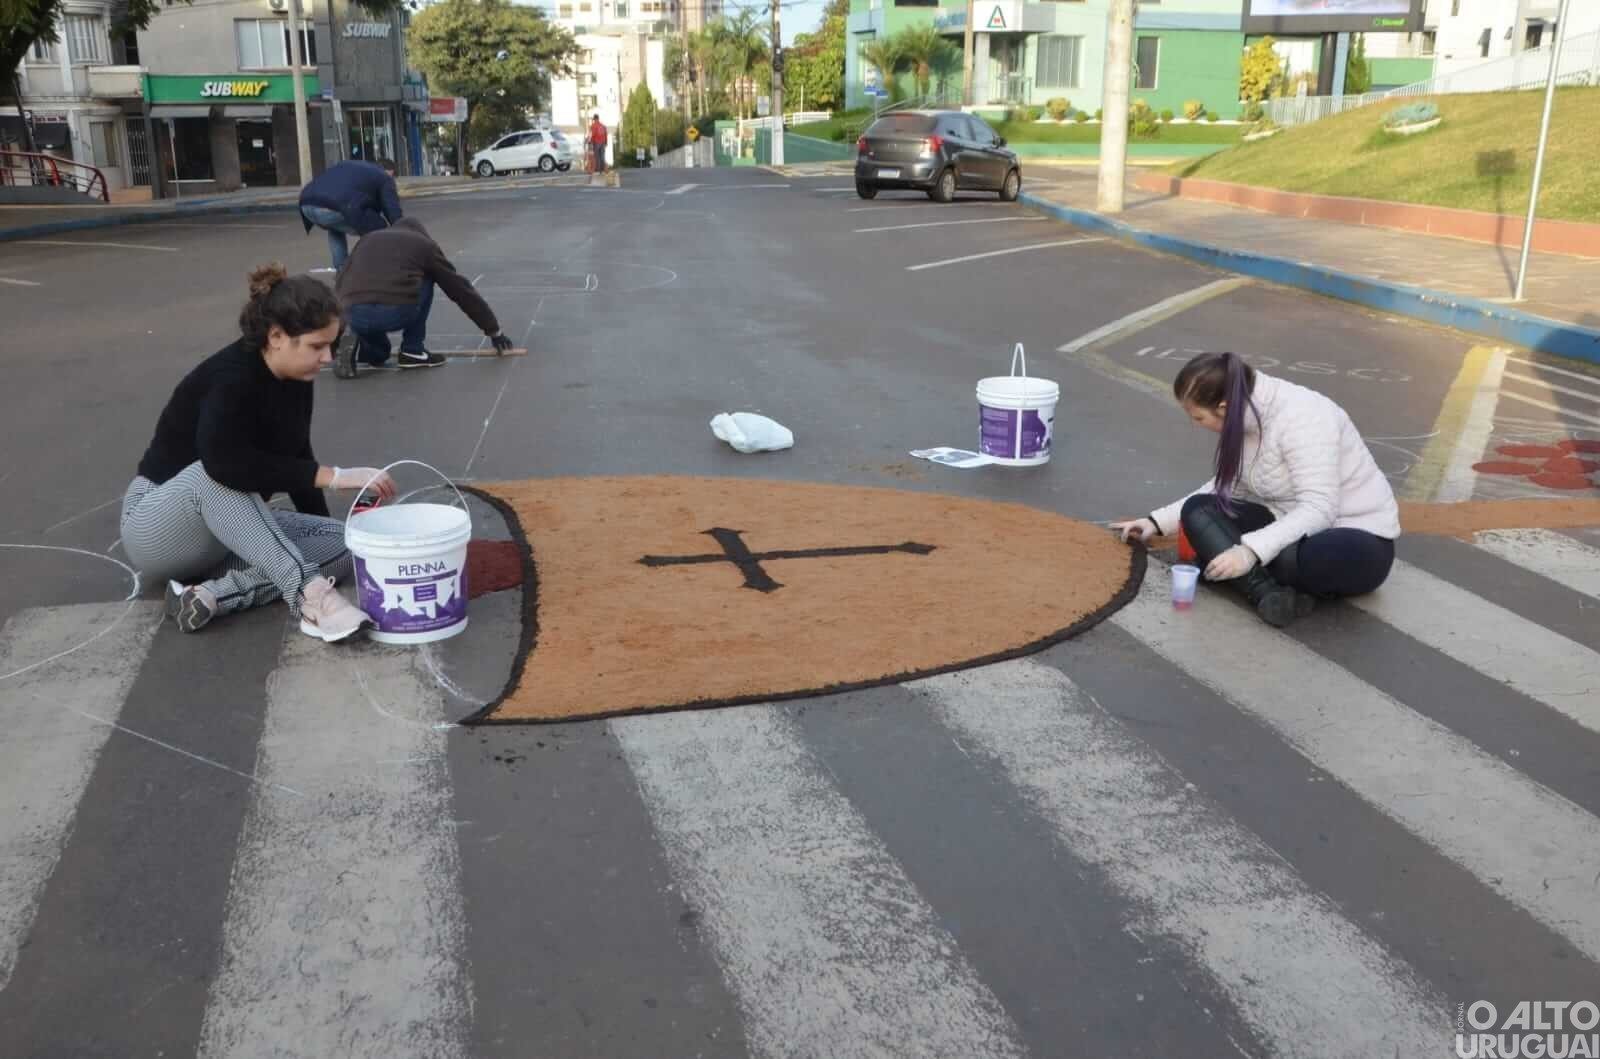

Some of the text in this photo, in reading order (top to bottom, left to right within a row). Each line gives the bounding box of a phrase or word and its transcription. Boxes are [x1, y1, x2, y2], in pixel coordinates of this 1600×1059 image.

[342, 23, 392, 38] SUBWAY
[200, 80, 268, 97] SUBWAY
[398, 560, 446, 577] PLENNA
